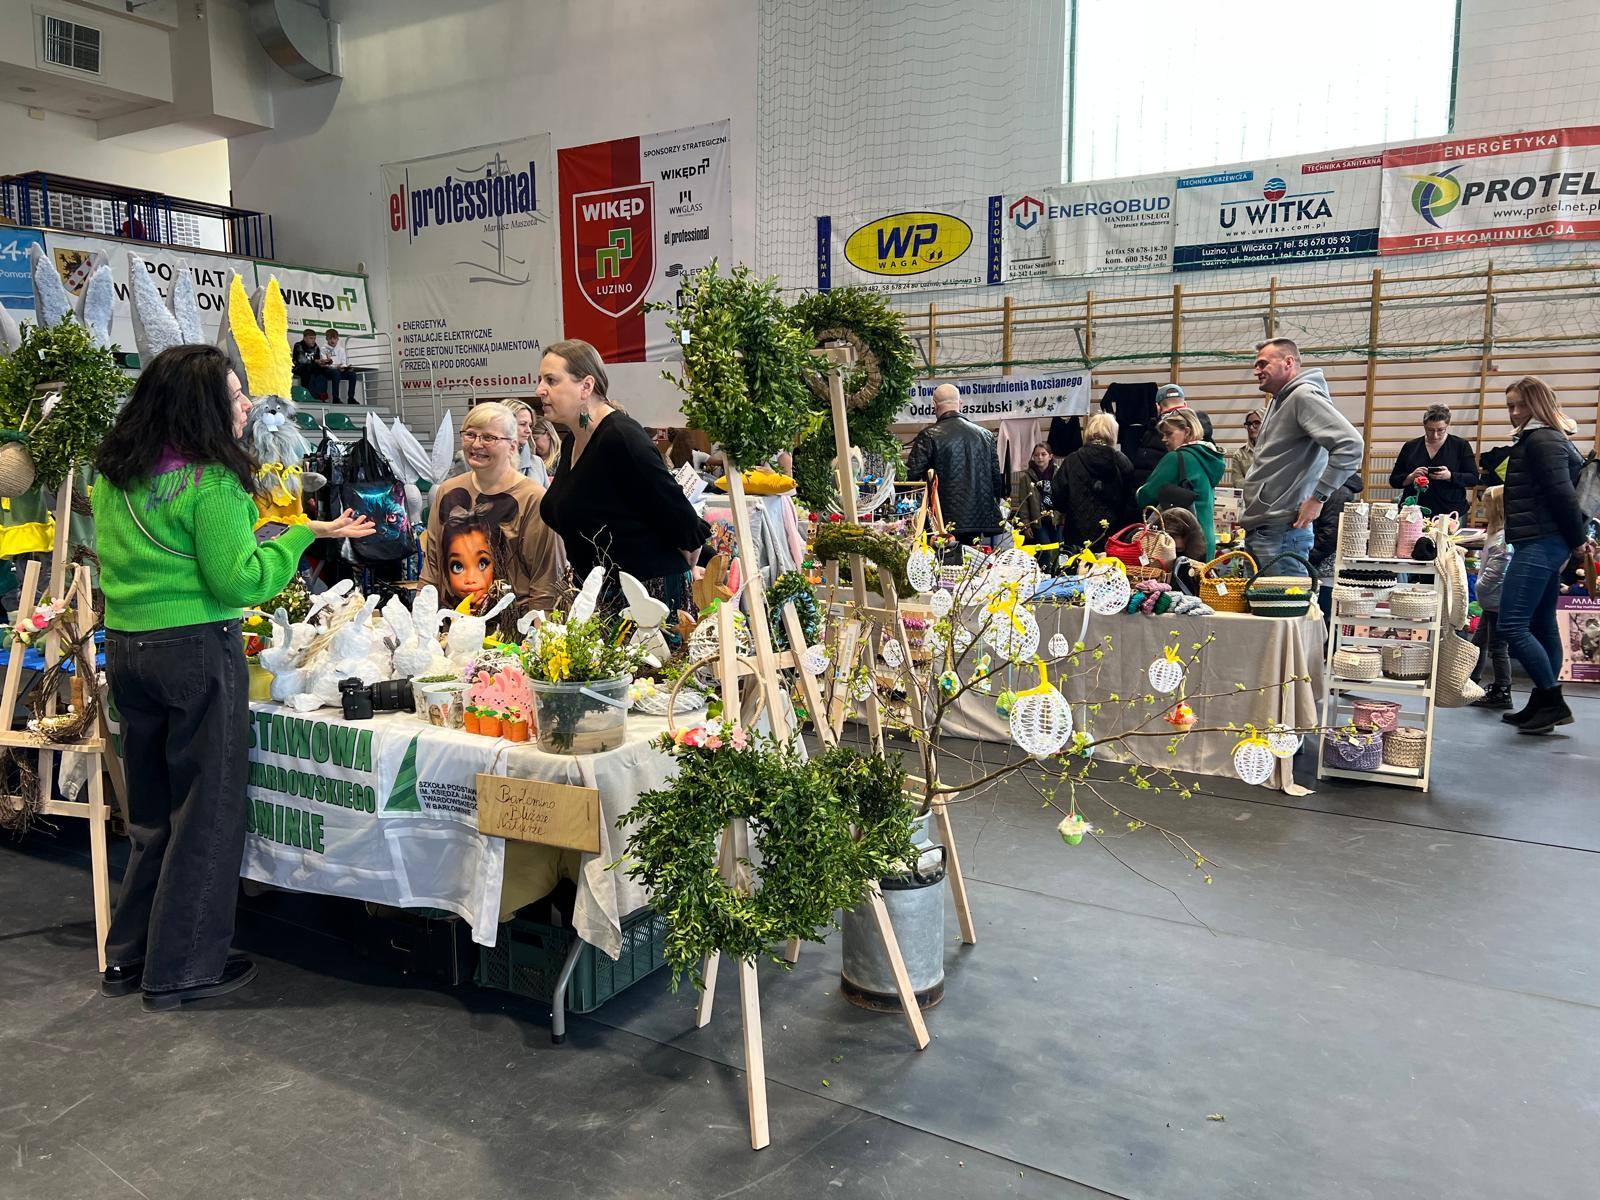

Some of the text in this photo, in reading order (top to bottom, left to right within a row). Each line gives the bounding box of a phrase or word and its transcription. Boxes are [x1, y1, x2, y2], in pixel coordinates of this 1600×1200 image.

[643, 136, 727, 158] SPONSORZY STRATEGICZNI
[1444, 134, 1558, 158] ENERGETYKA
[1307, 157, 1381, 172] TECHNIKA SANITARNA
[661, 166, 697, 180] WIKĘD
[1182, 177, 1213, 186] TECHNIKA
[1461, 171, 1600, 206] PROTEL
[390, 160, 537, 236] el professional
[582, 197, 645, 222] WIKĘD
[669, 203, 703, 215] WWGLASS
[1048, 196, 1171, 219] ENERGOBUD
[1219, 197, 1332, 228] U WITKA
[1105, 214, 1135, 223] HANDEL
[671, 226, 710, 246] professional
[877, 222, 938, 260] WP
[1414, 225, 1576, 248] TELEKOMUNIKACJA
[1202, 248, 1228, 256] Luzino,
[1241, 243, 1273, 253] Wilczka
[1283, 241, 1296, 249] tel.
[1298, 239, 1309, 247] 58
[1310, 237, 1326, 246] 678
[1327, 236, 1339, 245] 05
[1339, 235, 1351, 244] 93
[878, 258, 918, 270] WAGA
[1125, 255, 1138, 263] 600
[1139, 254, 1153, 262] 356
[1154, 253, 1167, 261] 203
[144, 262, 225, 288] POIAT
[974, 276, 982, 284] 13
[596, 283, 633, 295] LUZINO
[402, 319, 447, 331] ENERGETYKA
[403, 328, 493, 344] INSTALACJE ELEKTRYCZNE
[426, 345, 454, 356] BETONU
[455, 343, 490, 355] TECHNIKĄ
[490, 339, 540, 352] DIAMENTOWĄ
[439, 359, 454, 369] POD
[455, 357, 488, 368] DROGAMI
[972, 380, 1029, 395] Stwardnienia
[1030, 376, 1083, 391] Rozsianego
[910, 400, 1013, 416] Oddz aszubski
[249, 709, 373, 773] STAWOWA
[418, 781, 477, 796] SZKOŁA PODSTAW
[430, 789, 460, 798] KSIĘDZA
[432, 804, 472, 816] BARŁOMINIE
